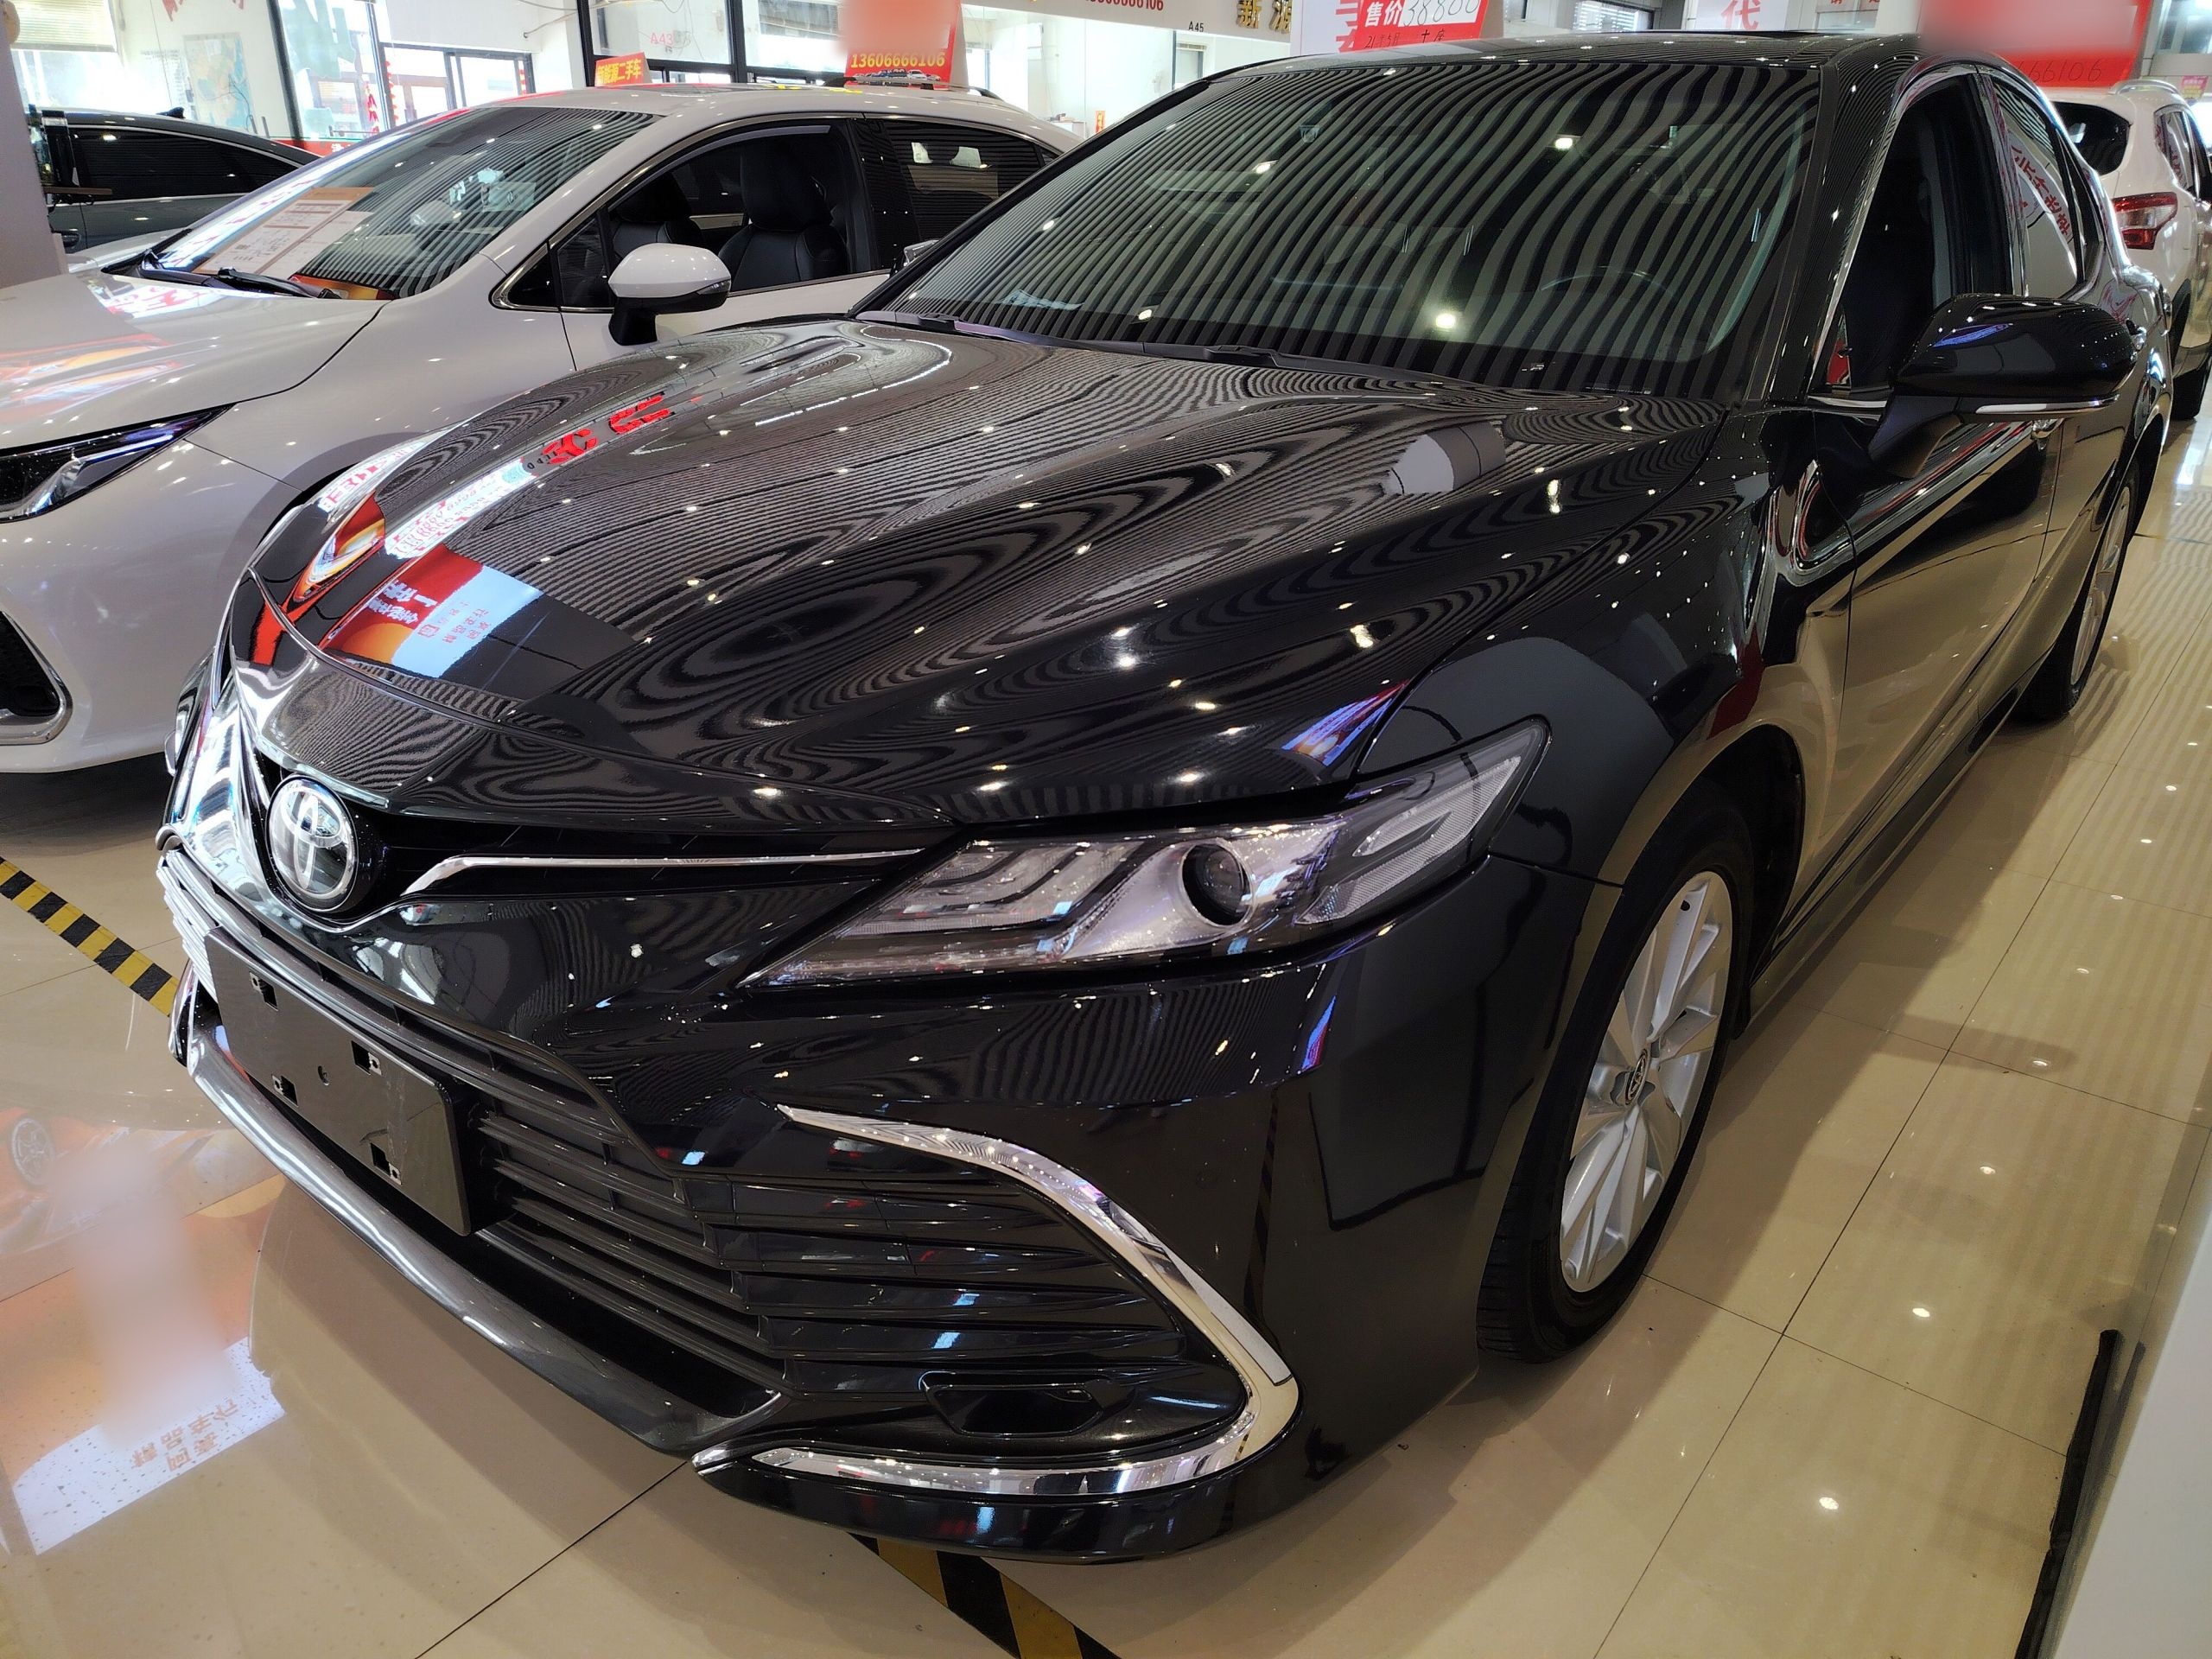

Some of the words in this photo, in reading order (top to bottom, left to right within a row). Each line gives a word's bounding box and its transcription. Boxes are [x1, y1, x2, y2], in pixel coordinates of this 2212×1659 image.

[1365, 0, 1402, 27] 售价
[1188, 21, 1204, 33] A45
[651, 32, 674, 46] A43
[850, 52, 945, 68] 13606666106
